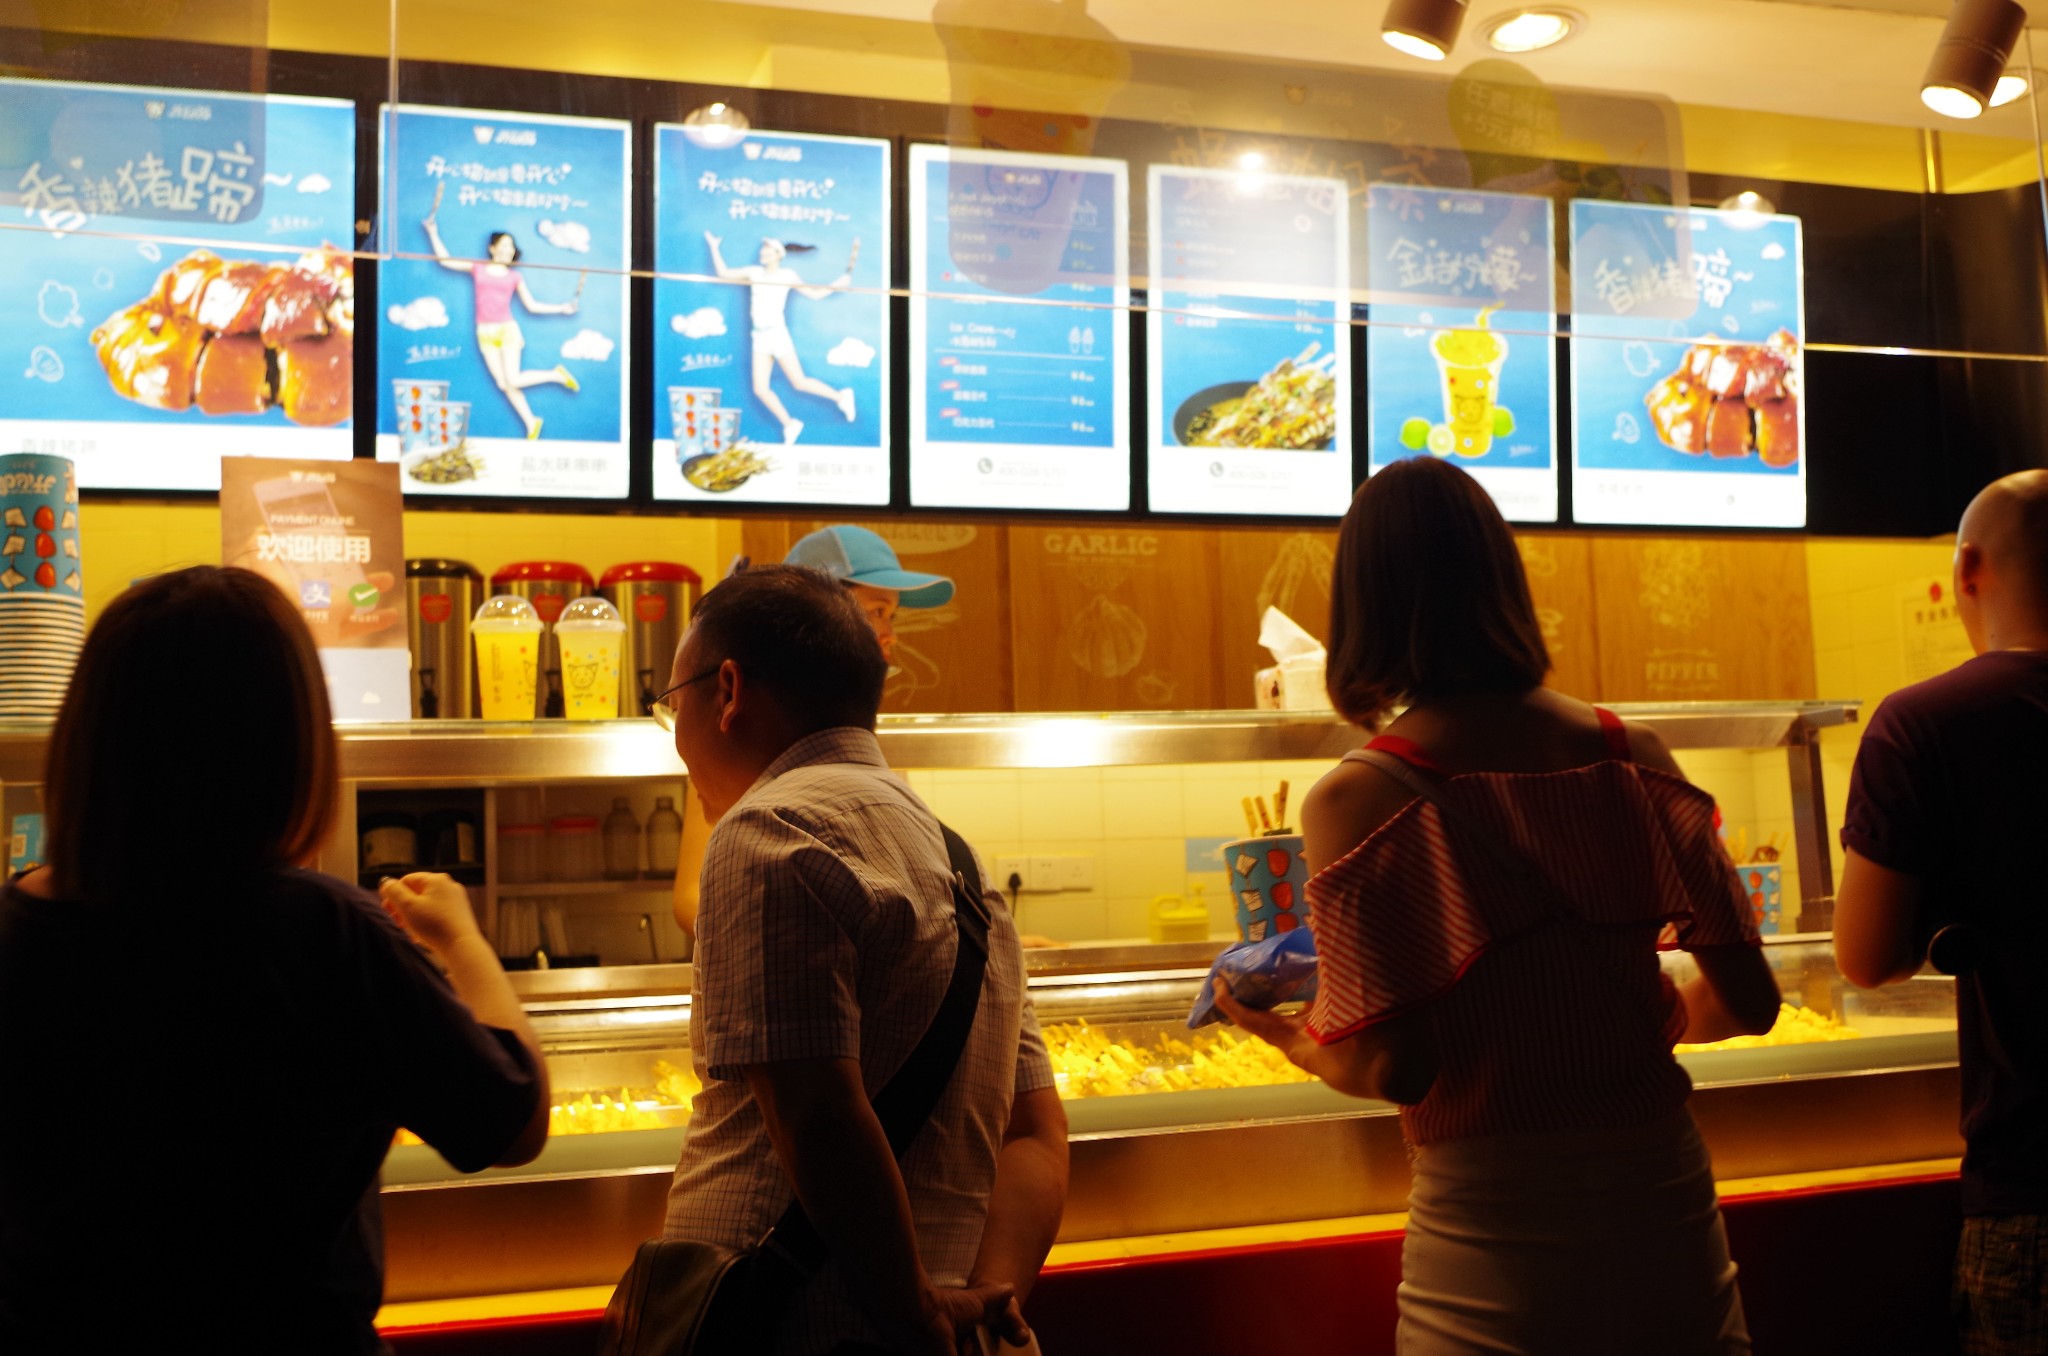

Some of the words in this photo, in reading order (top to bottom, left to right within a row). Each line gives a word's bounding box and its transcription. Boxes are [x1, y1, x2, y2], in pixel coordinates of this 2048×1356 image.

[269, 513, 318, 526] PAYMENT
[320, 515, 356, 527] ONLINE
[256, 534, 372, 564] 欢迎使用
[1043, 533, 1159, 556] GARLIC
